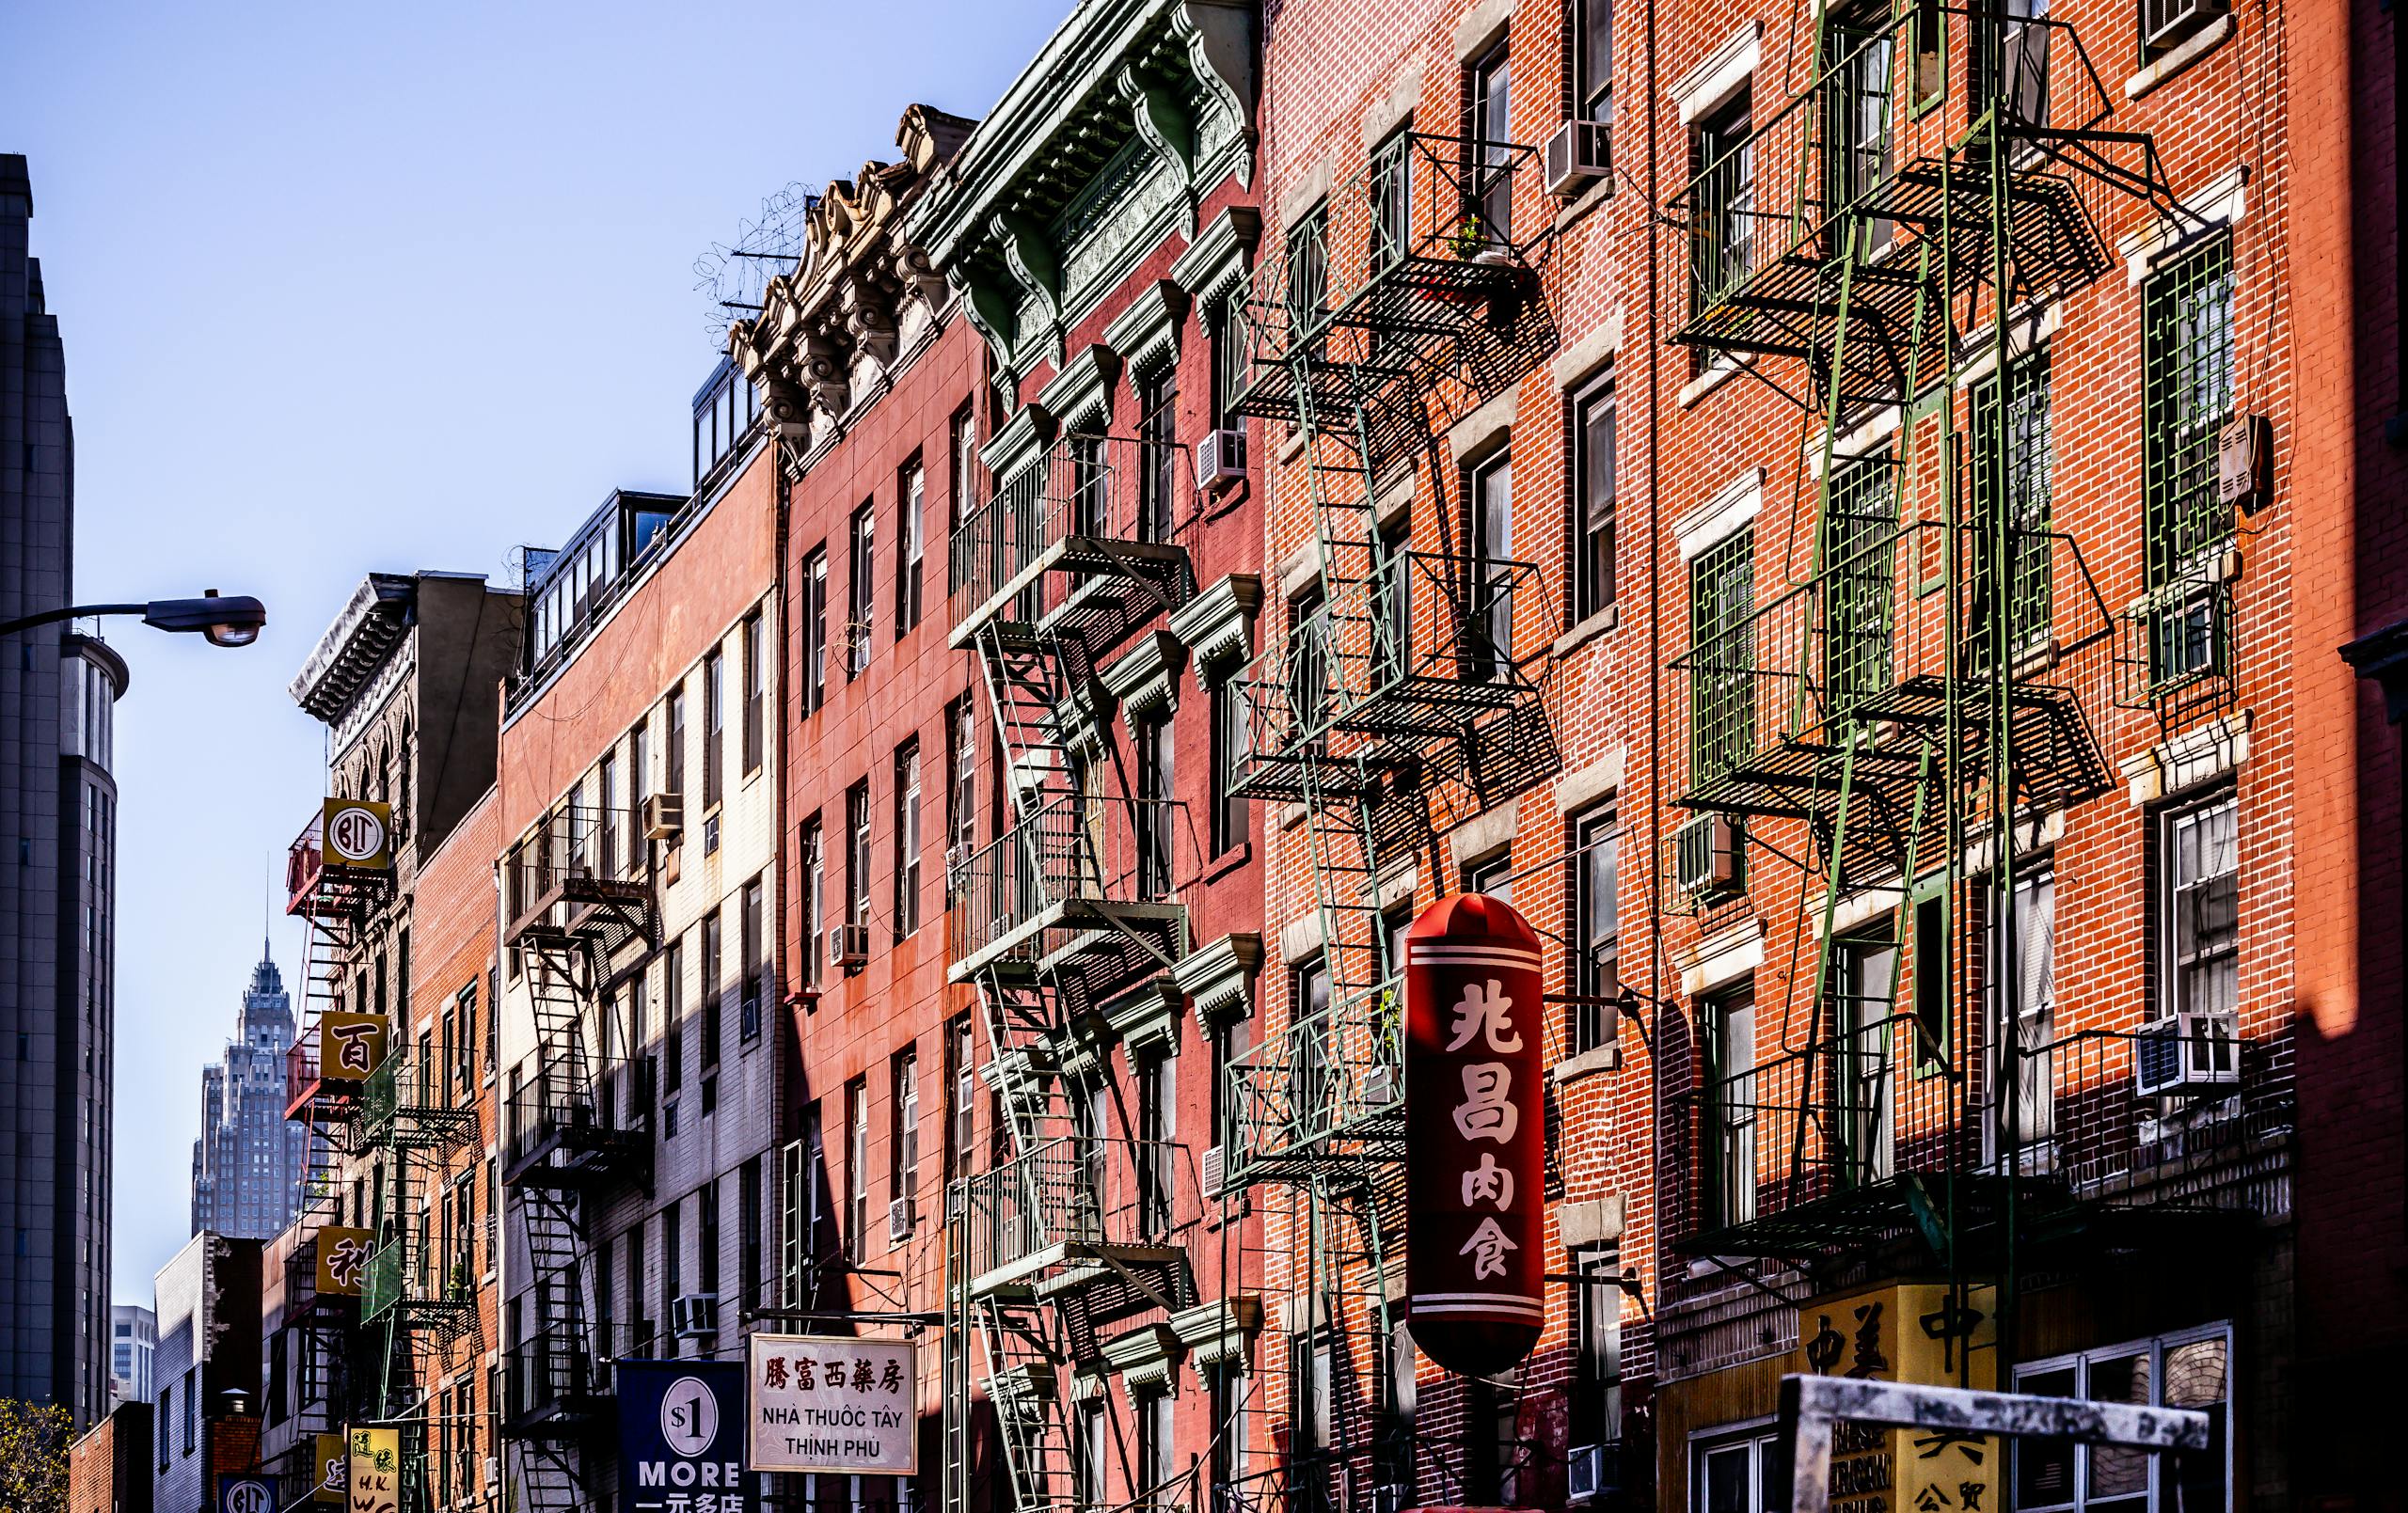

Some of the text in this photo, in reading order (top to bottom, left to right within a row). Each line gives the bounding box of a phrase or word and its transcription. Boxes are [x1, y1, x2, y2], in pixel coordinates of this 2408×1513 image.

[338, 814, 373, 853] BLT
[331, 1022, 379, 1073] 百
[1445, 979, 1524, 1282] 兆昌肉食
[671, 1396, 706, 1439] $1
[763, 1402, 800, 1426] NHÀ
[872, 1404, 903, 1428] TÂY
[358, 1475, 390, 1492] H.K.
[639, 1460, 739, 1488] MORE
